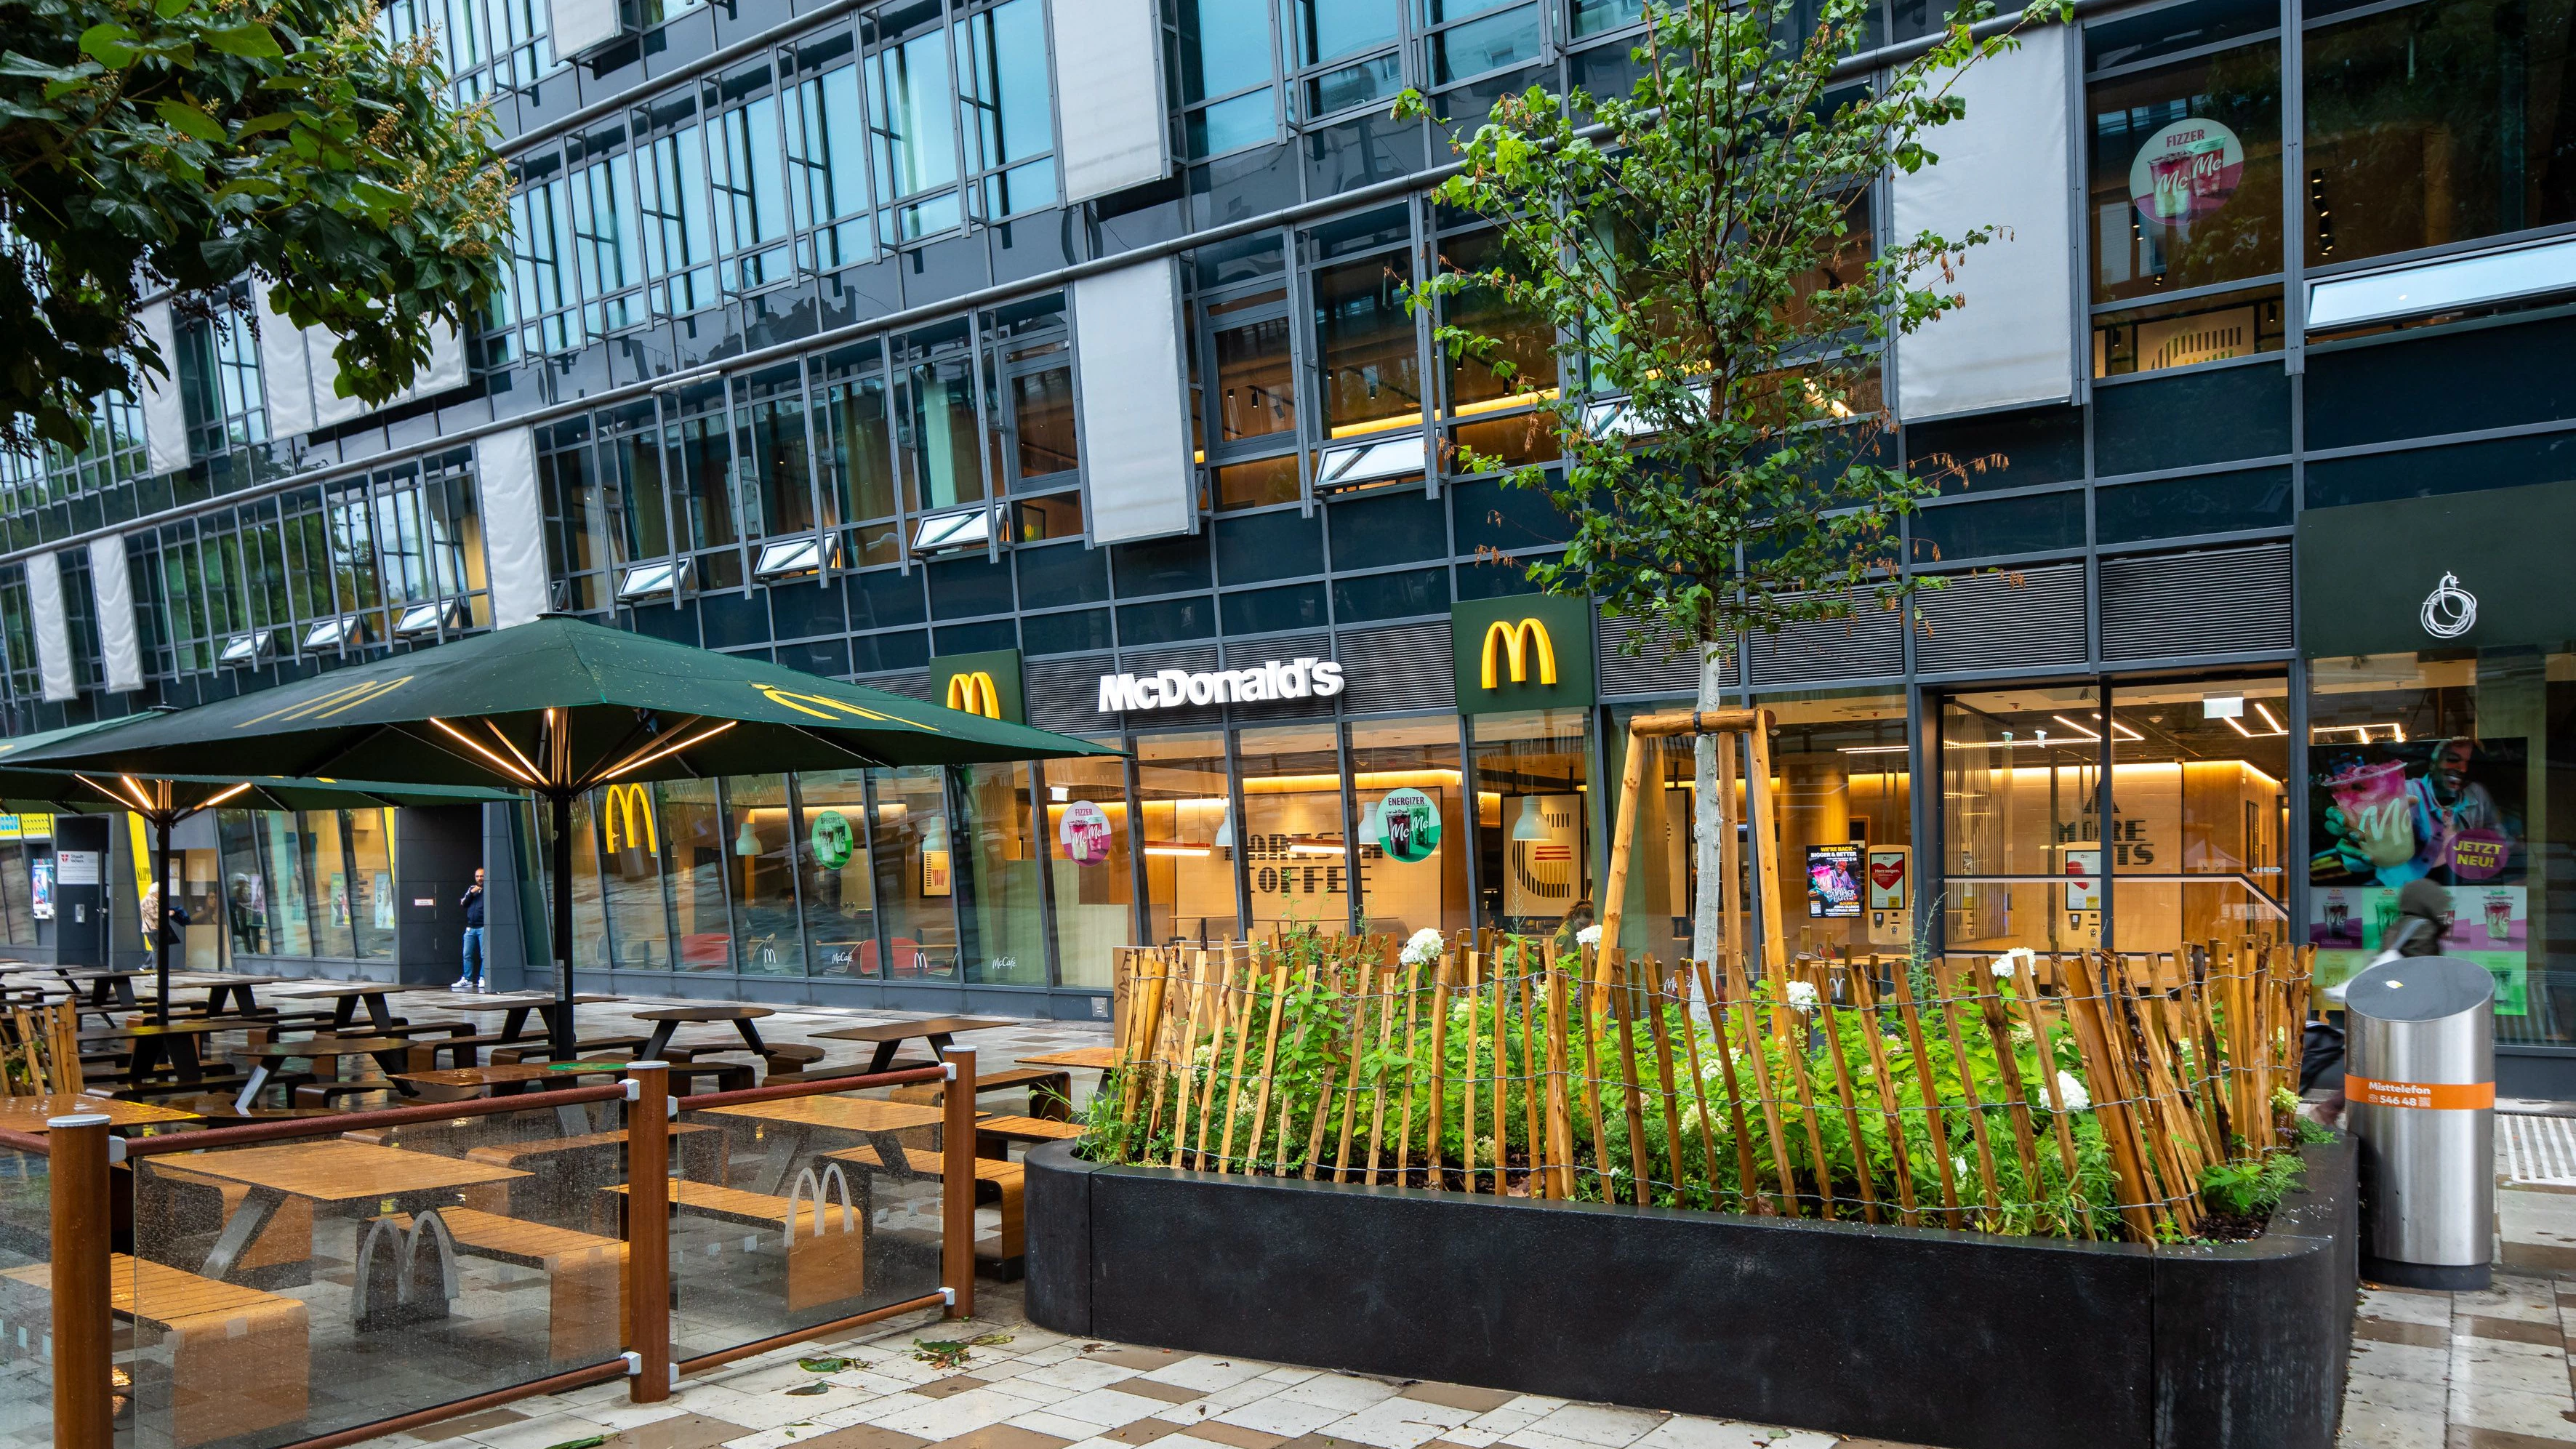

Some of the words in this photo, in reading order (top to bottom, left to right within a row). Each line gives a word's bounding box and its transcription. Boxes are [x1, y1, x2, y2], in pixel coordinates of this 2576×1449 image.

[2166, 129, 2205, 148] FIZZER
[2192, 153, 2222, 179] Mc
[2156, 170, 2188, 195] Mc
[1098, 657, 1344, 713] McDonald's
[1388, 797, 1425, 806] ENERGIZER
[1390, 823, 1410, 841] Mc
[1411, 816, 1429, 832] Mc
[2453, 840, 2503, 855] JETZT
[2456, 854, 2495, 868] NEU!
[2368, 1081, 2431, 1095] Misttelefon
[2379, 1094, 2400, 1105] 546
[2402, 1097, 2417, 1107] 48
